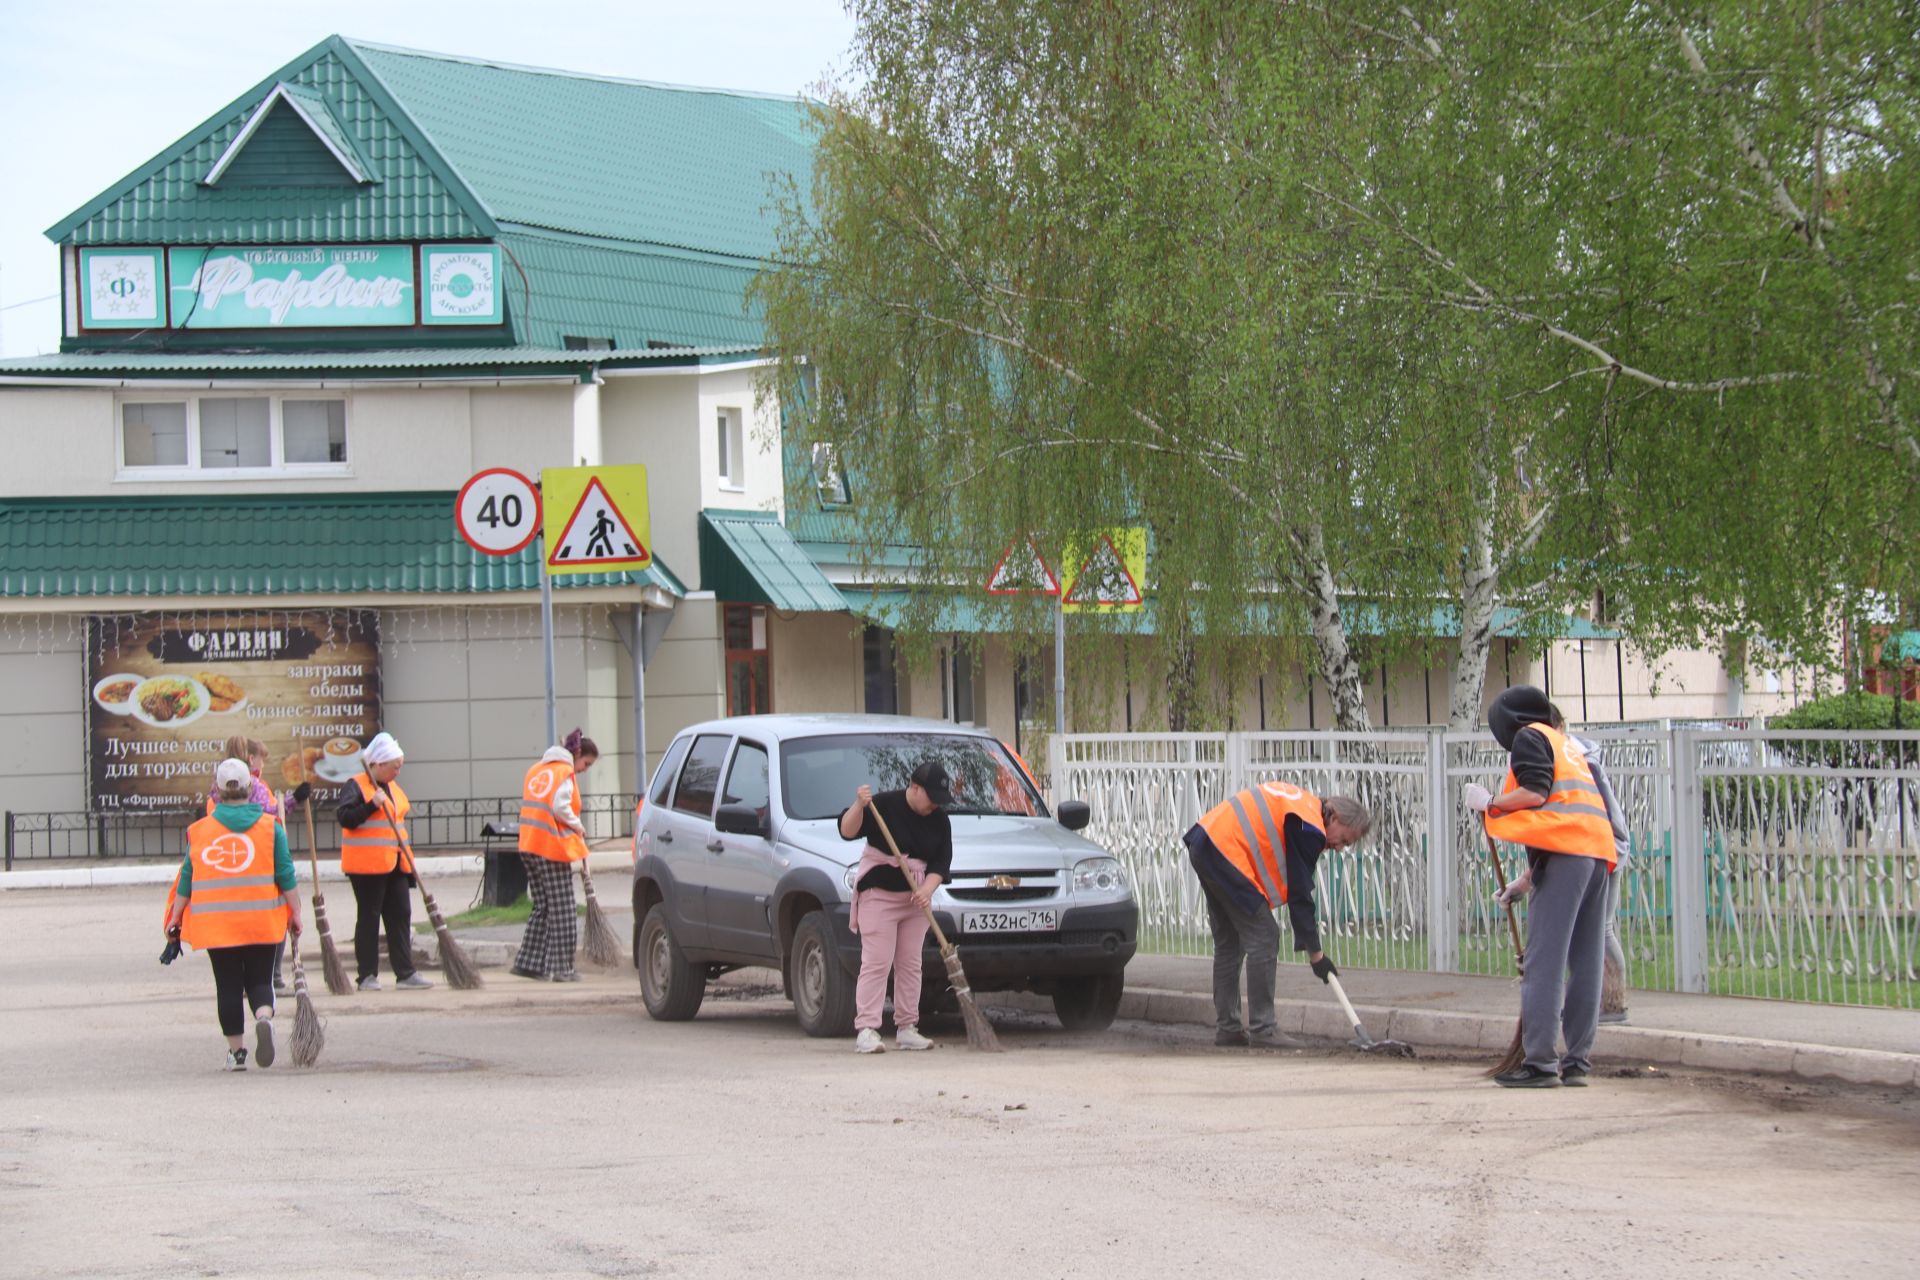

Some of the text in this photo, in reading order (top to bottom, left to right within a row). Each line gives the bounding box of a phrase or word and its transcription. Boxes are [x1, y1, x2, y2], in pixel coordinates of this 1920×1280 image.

[243, 248, 379, 265] ТОРГОВЫЙ ЦЕНТР
[188, 255, 404, 325] Фарвин
[476, 494, 522, 528] 40
[188, 630, 282, 651] ФАРВИН
[287, 664, 363, 680] завтраки
[310, 681, 363, 698] обеды
[246, 703, 364, 720] бизнес-ланчи
[291, 723, 364, 737] выпечка
[104, 737, 226, 760] Лучшее мест
[105, 760, 220, 780] для торжест
[98, 793, 120, 808] ТЦ
[1030, 912, 1051, 924] 716
